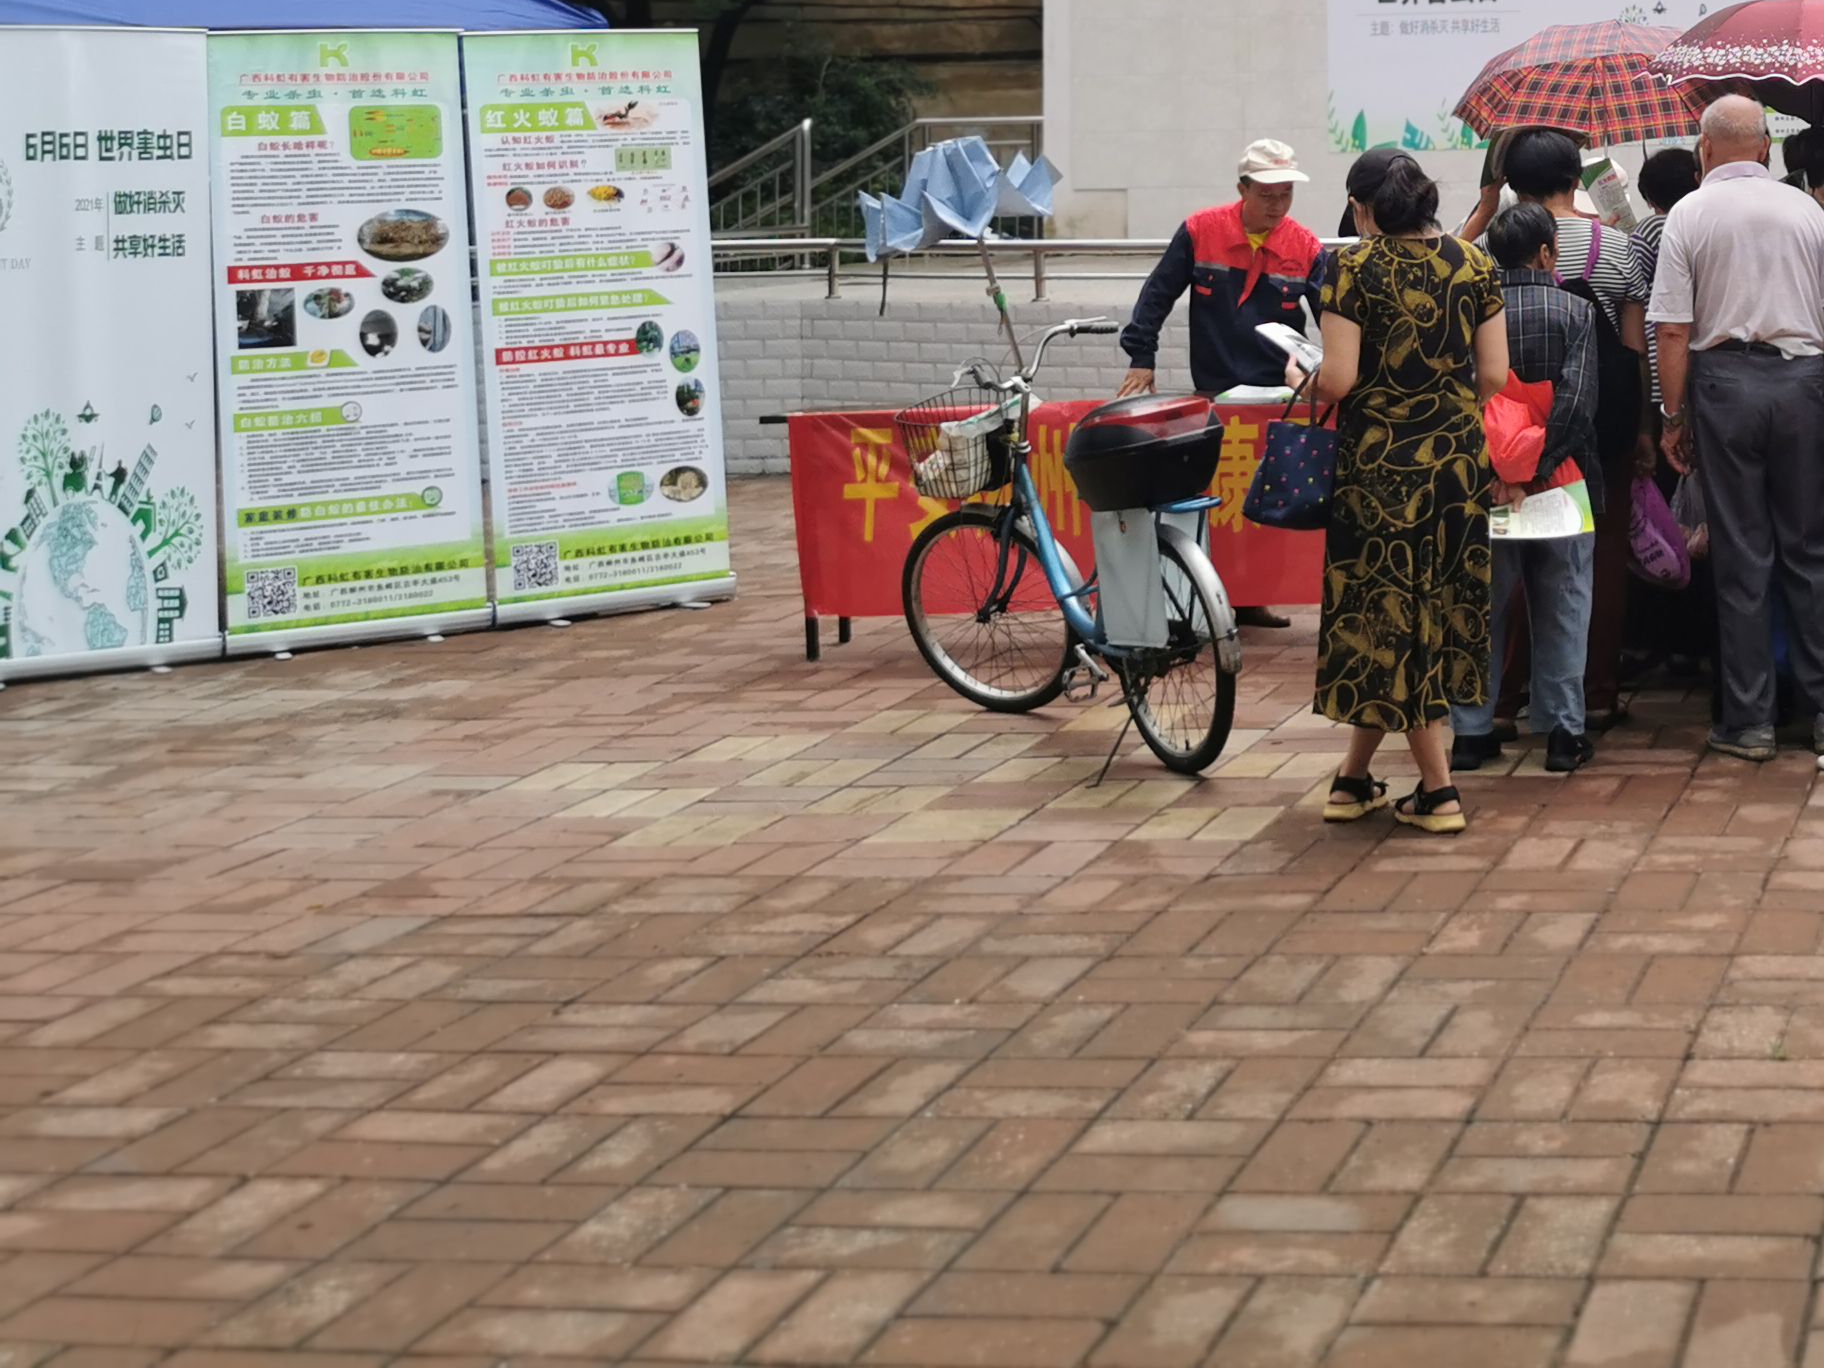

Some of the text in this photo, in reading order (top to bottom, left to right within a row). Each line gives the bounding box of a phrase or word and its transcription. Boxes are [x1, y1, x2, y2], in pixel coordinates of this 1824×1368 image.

[227, 110, 312, 131] 白蚁篇
[486, 107, 584, 128] 红火蚁篇
[25, 129, 193, 162] 6月6日 世界害虫日
[75, 198, 104, 212] 2021年
[114, 190, 186, 215] 做好消杀灭
[113, 233, 186, 259] 共享好生活
